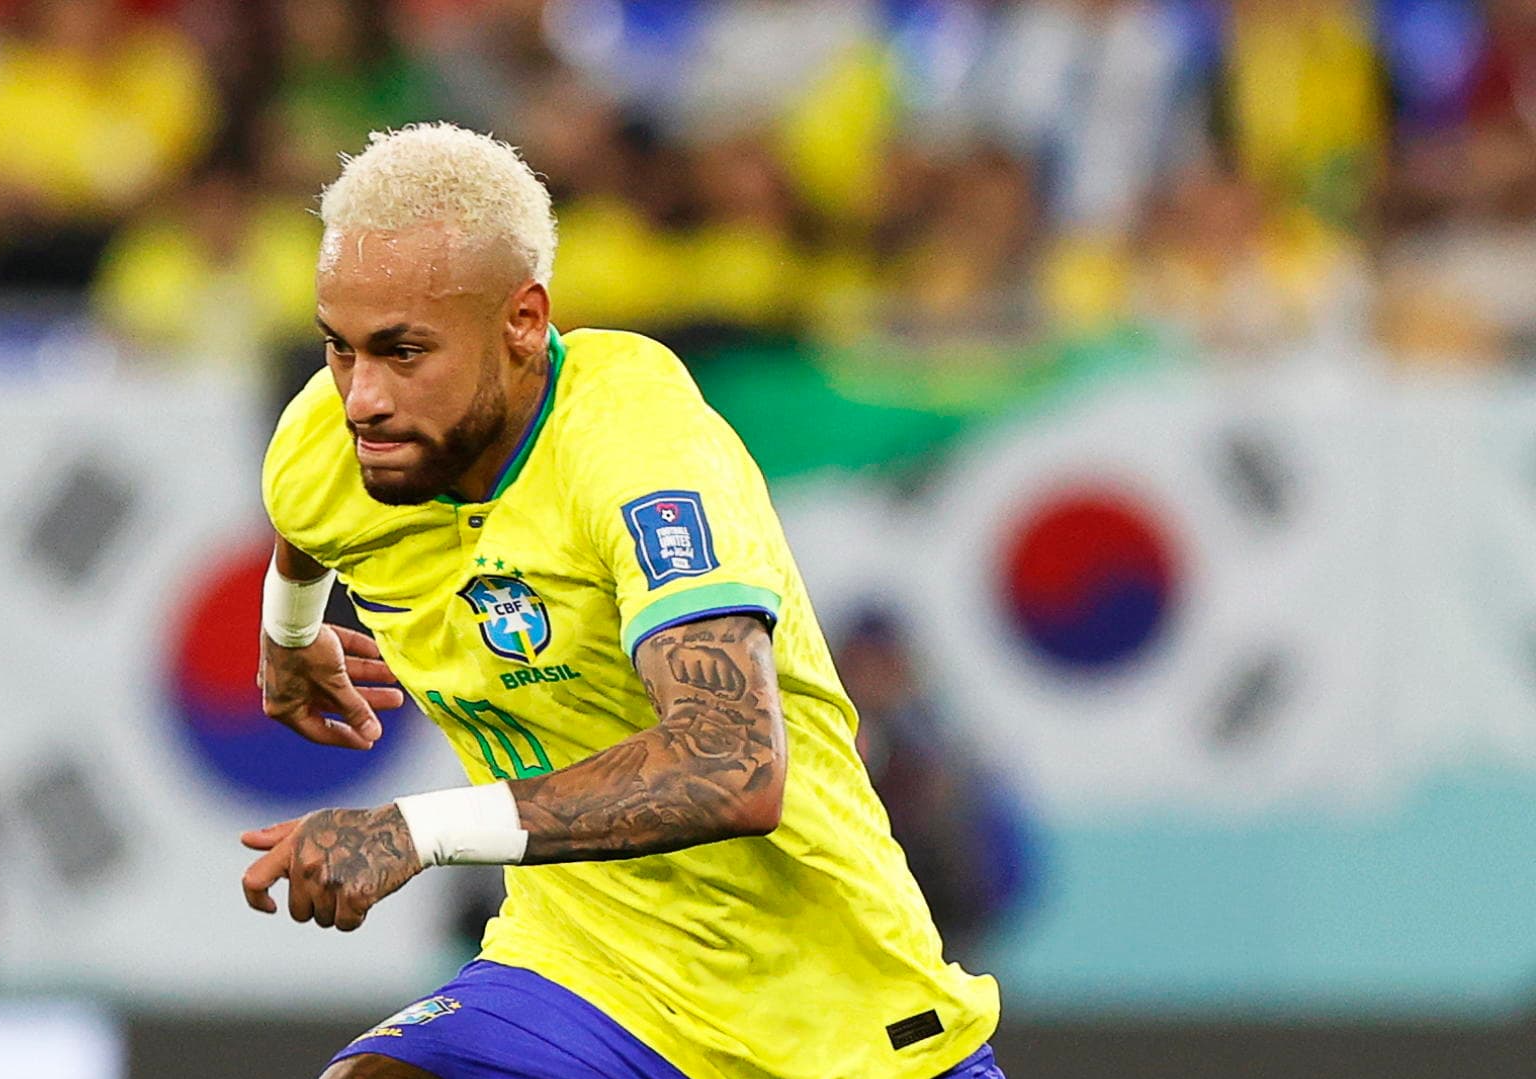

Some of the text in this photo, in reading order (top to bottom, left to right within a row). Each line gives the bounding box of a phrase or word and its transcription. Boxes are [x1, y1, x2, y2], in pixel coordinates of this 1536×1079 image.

[494, 600, 524, 616] CBF
[500, 664, 582, 690] BRASIL
[426, 690, 555, 780] 10
